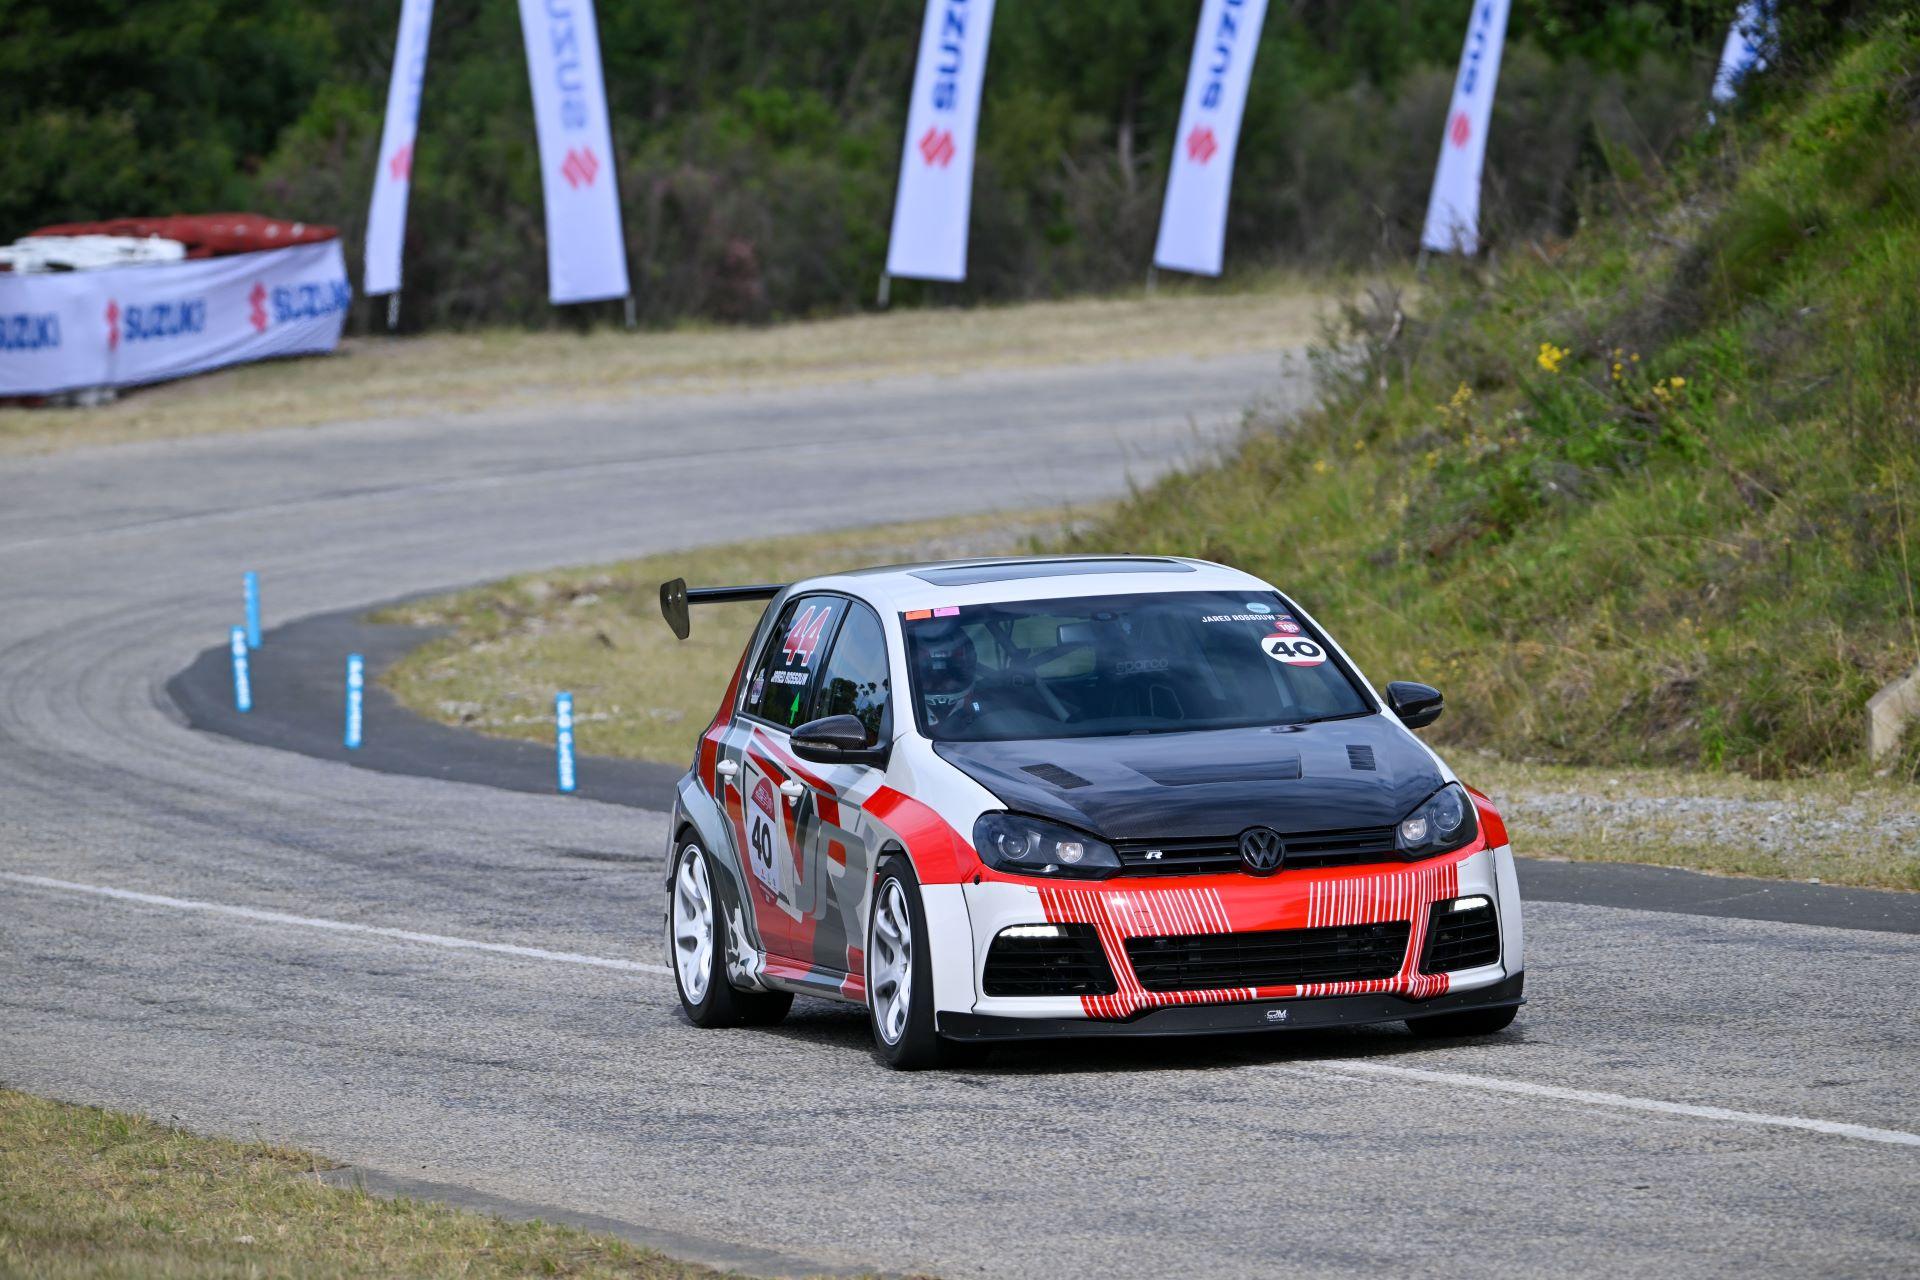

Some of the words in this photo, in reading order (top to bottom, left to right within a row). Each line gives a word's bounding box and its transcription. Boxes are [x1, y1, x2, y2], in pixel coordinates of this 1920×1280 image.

[933, 0, 968, 110] SUZ
[1203, 0, 1242, 108] SUZ
[125, 301, 206, 340] SUZUKI
[783, 606, 831, 667] 44
[1202, 615, 1231, 623] JARED
[1271, 641, 1321, 657] 40
[752, 815, 772, 869] 40
